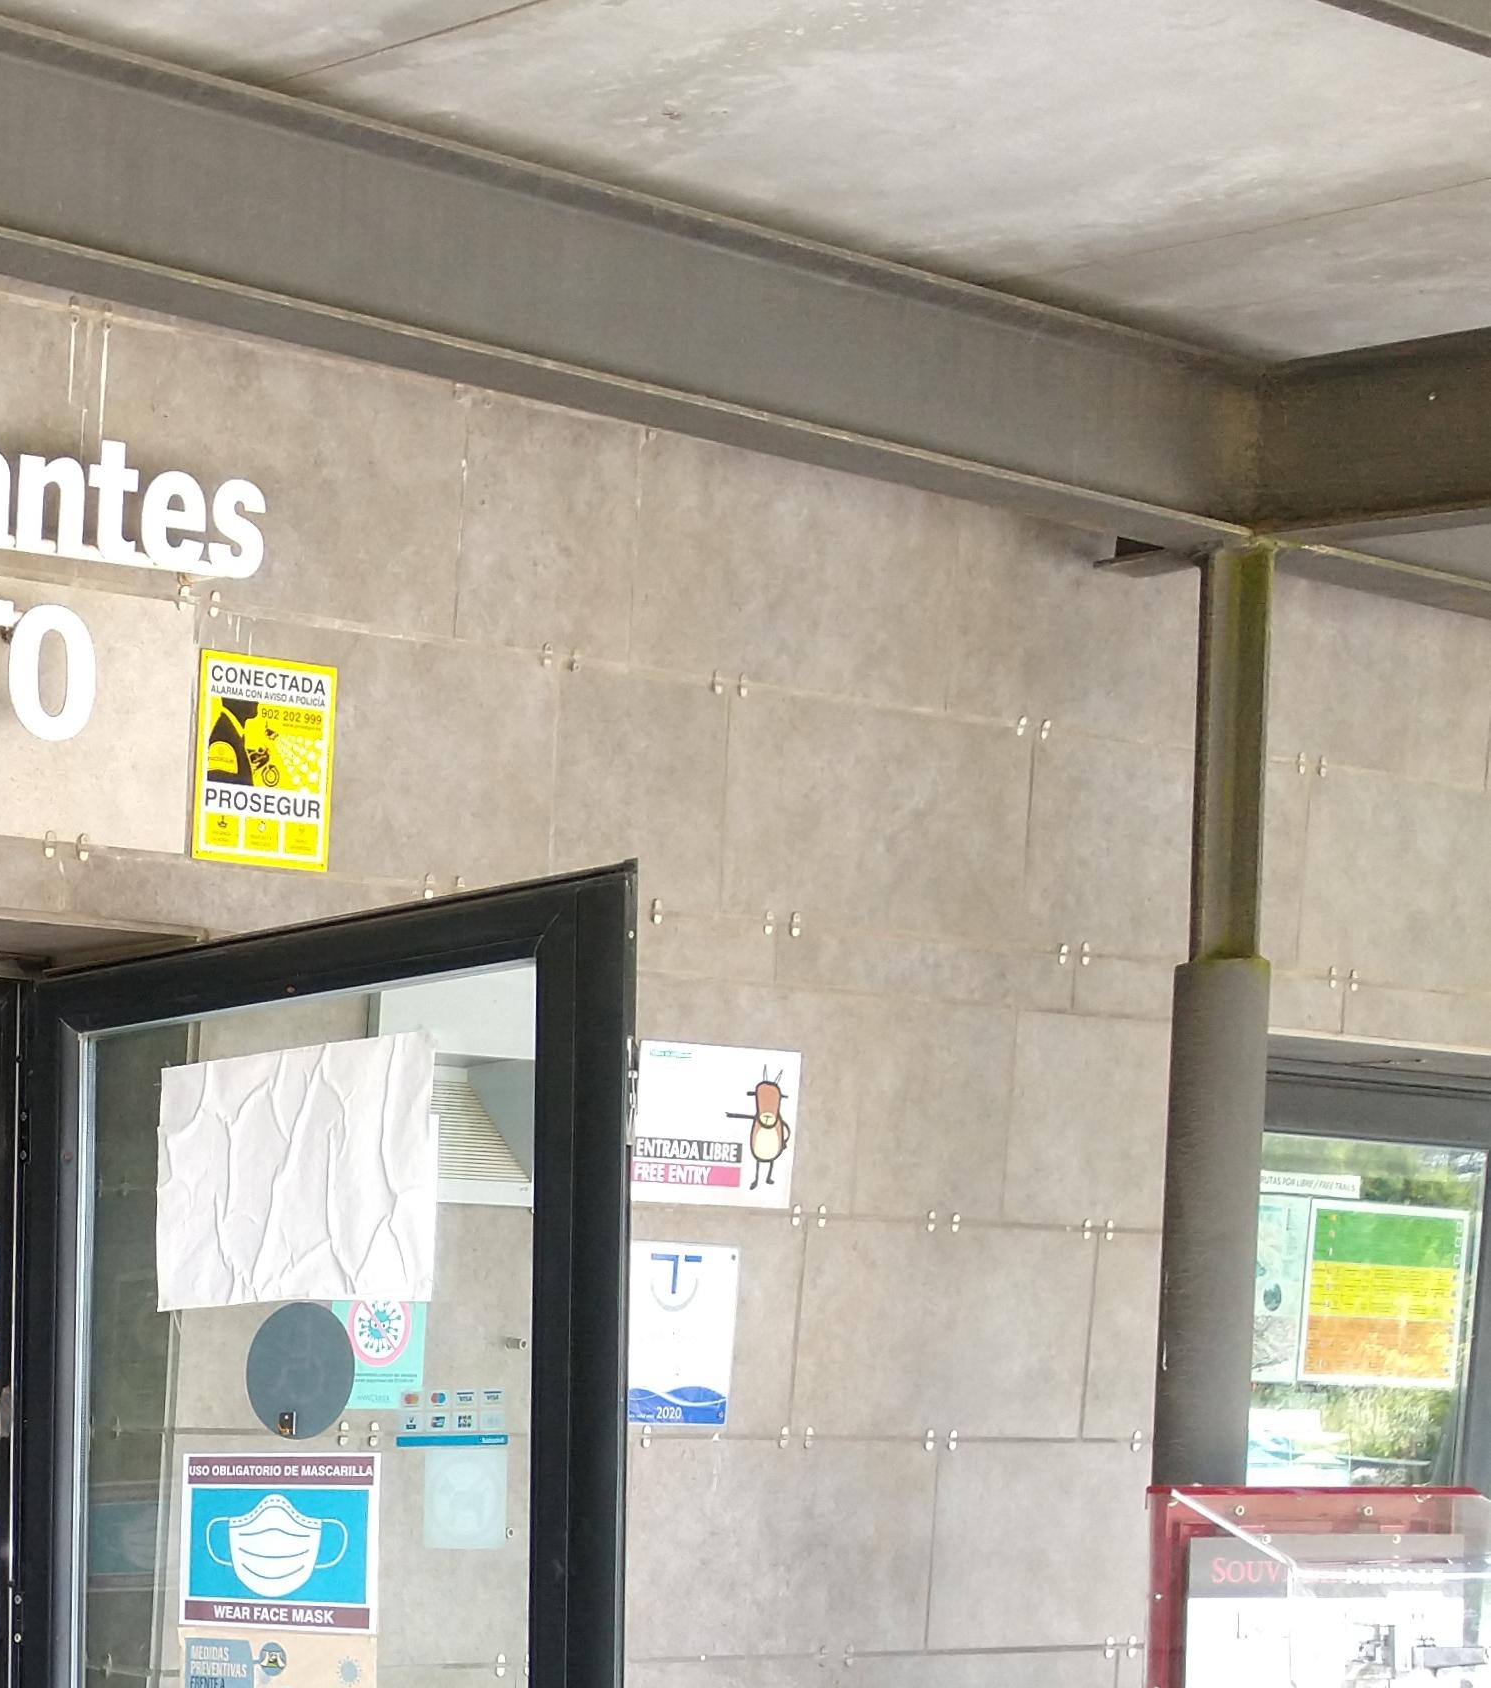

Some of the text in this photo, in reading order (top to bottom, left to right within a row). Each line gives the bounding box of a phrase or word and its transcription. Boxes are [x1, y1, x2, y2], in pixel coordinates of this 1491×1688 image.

[211, 665, 326, 696] CONECTADA
[211, 685, 326, 708] ALARMA CON AVISO A POLICÍA
[261, 708, 322, 725] 902 202 999
[204, 788, 321, 820] PROSEGUR
[636, 1138, 738, 1162] ENTRADA LIBRE
[633, 1162, 711, 1184] FREE ENTRY
[656, 1406, 682, 1420] 2020
[189, 1465, 374, 1478] USO OBLIGATORIO DE MASCARILLA
[213, 1605, 335, 1625] WEAR FACE MASK
[191, 1645, 230, 1661] MEDIDAS
[190, 1661, 248, 1677] PREVENTIVAS
